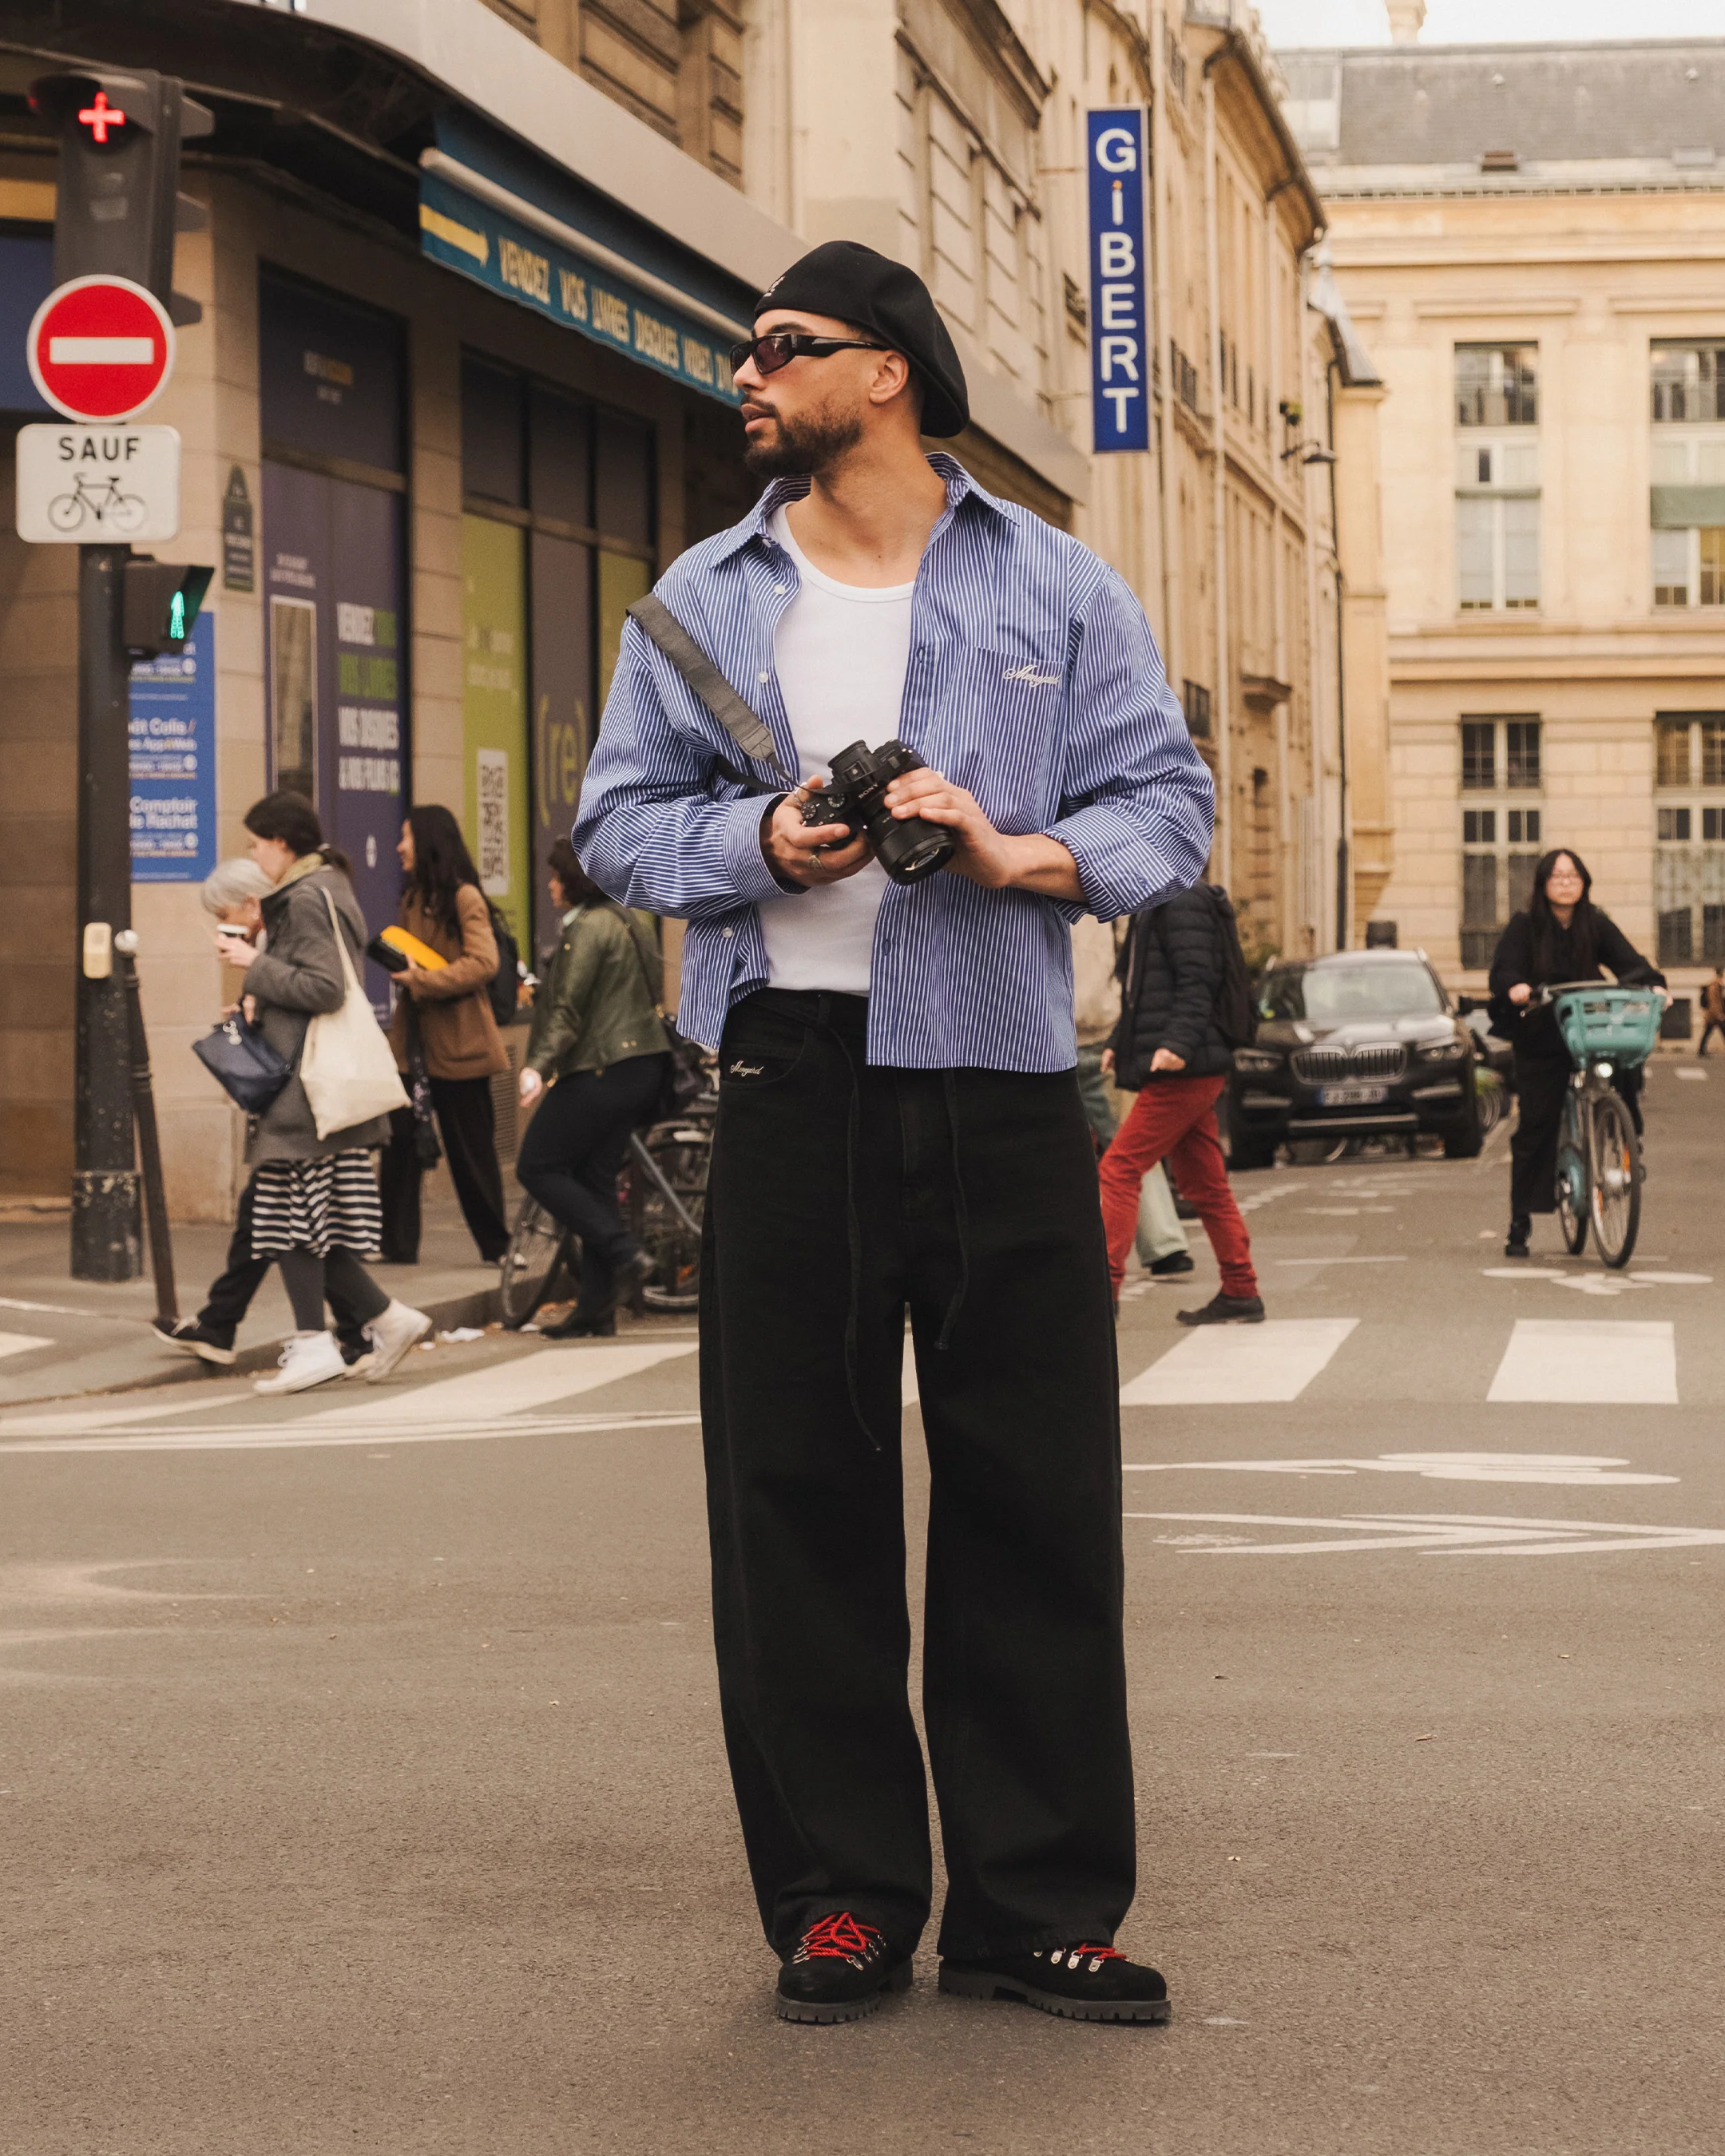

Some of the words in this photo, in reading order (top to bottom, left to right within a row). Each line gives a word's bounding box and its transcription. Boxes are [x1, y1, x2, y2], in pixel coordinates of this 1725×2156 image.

[498, 235, 551, 305] VENDEZ
[558, 268, 589, 323] VOS
[58, 436, 140, 462] SAUF
[858, 783, 878, 799] SONY
[129, 795, 198, 815] Comptoir
